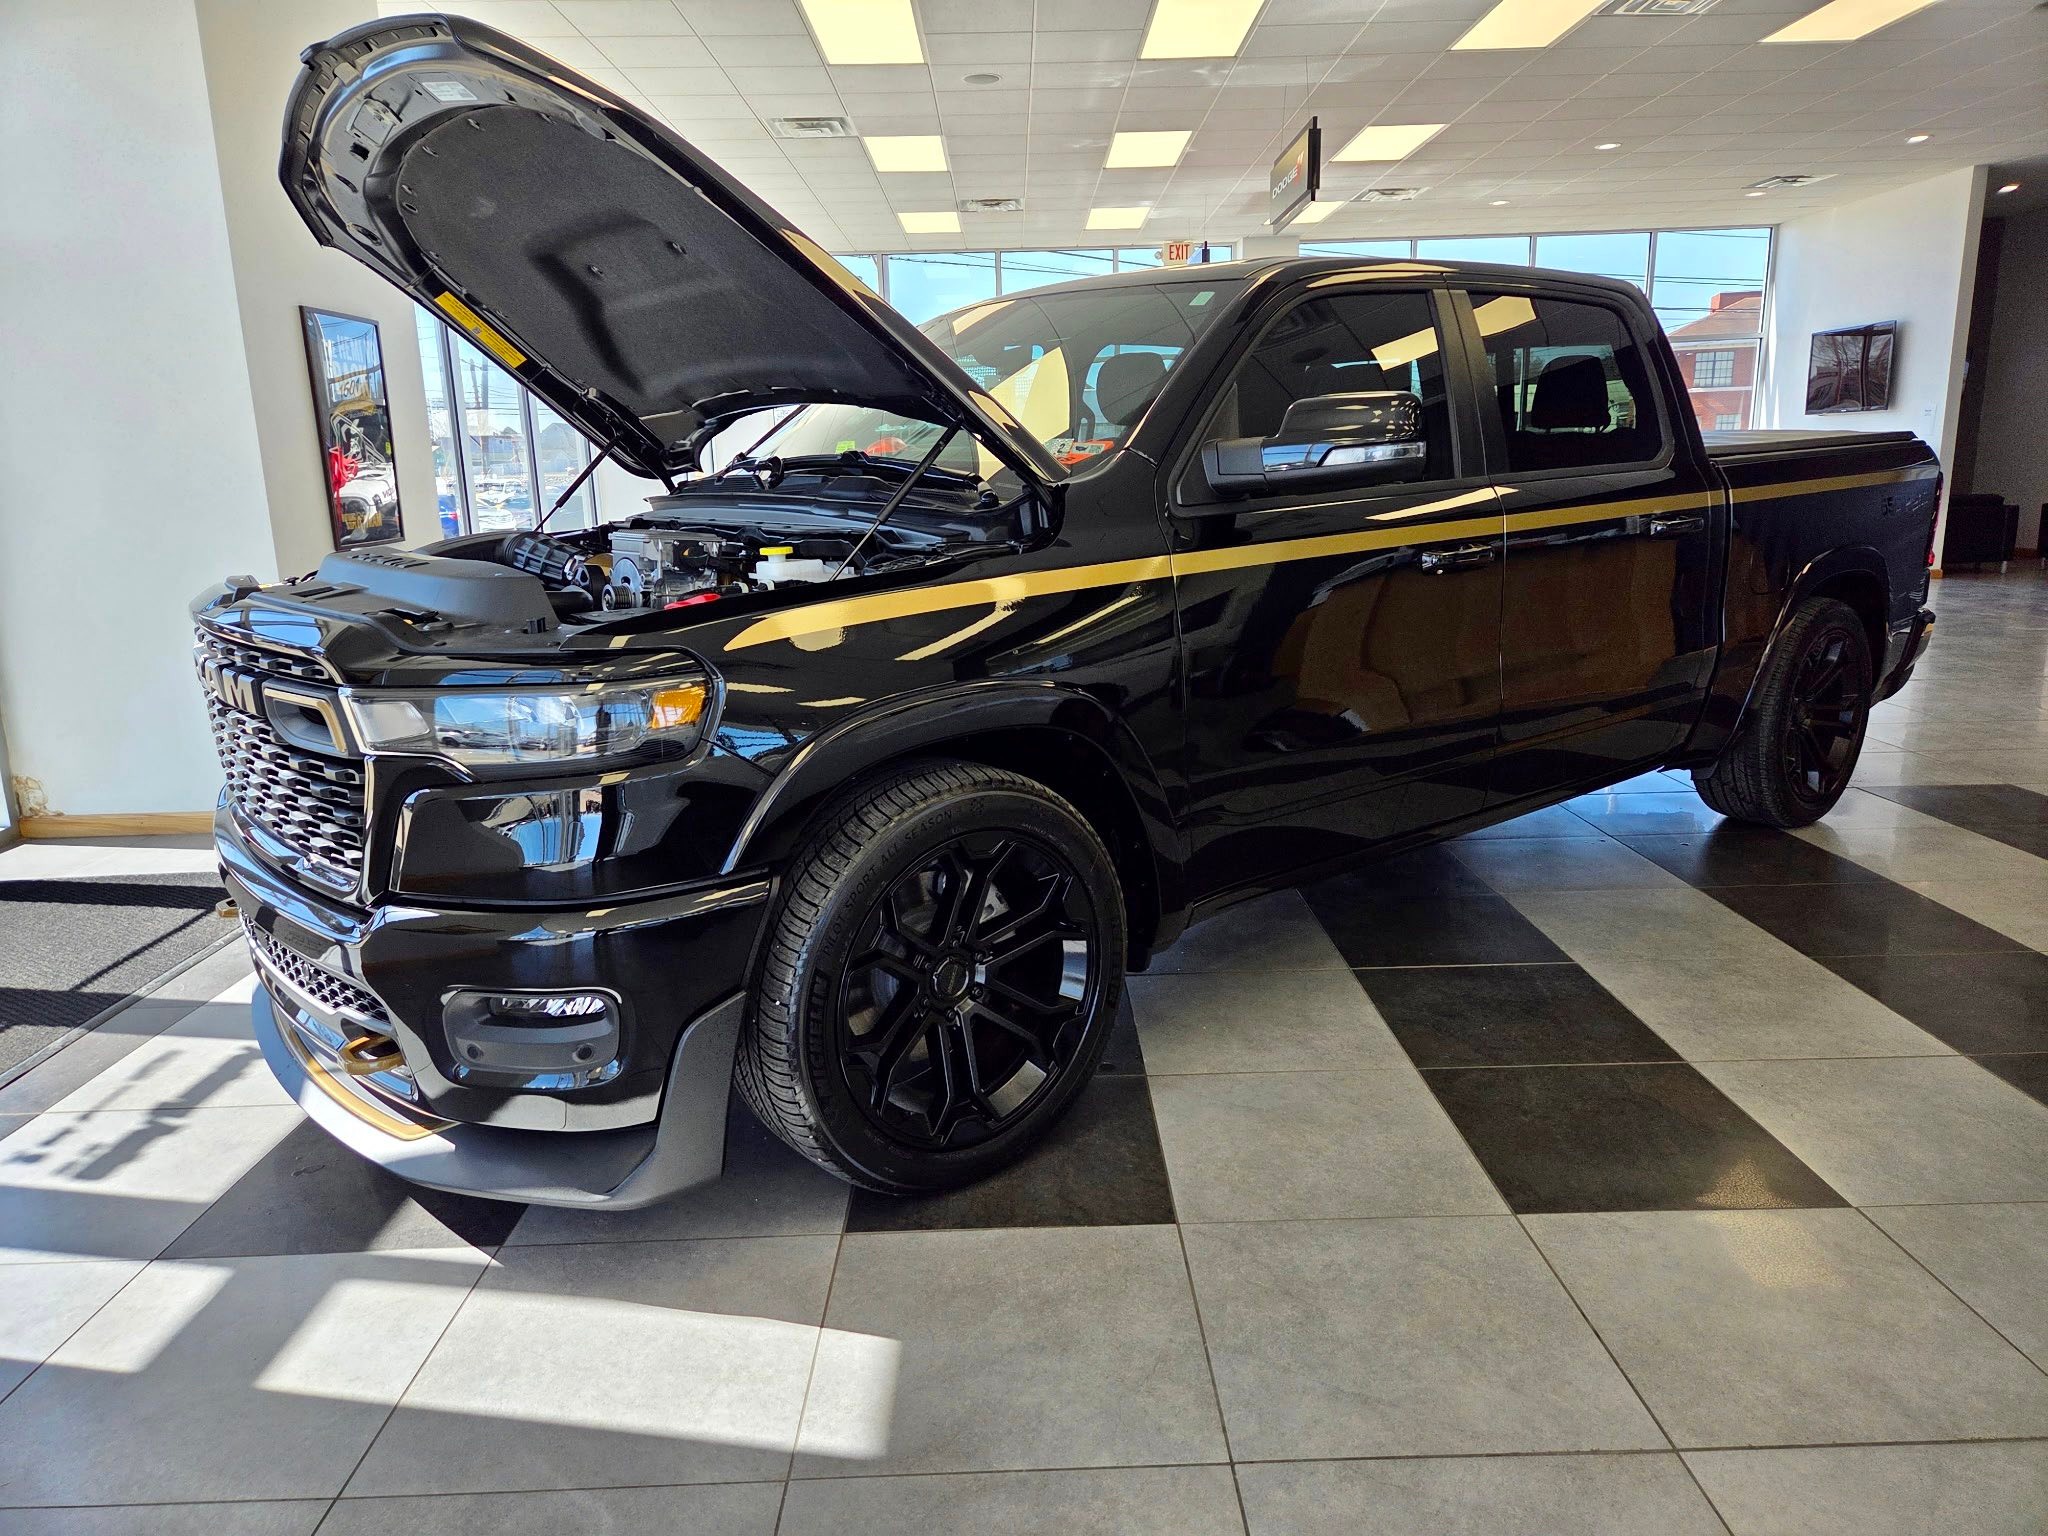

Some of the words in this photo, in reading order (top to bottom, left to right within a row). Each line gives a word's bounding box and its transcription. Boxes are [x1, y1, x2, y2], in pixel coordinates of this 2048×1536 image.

[1272, 167, 1299, 199] DODGE
[1169, 244, 1190, 260] EXIT
[845, 866, 880, 910] SPORT
[881, 841, 901, 864] ALL
[904, 810, 953, 841] SEASON
